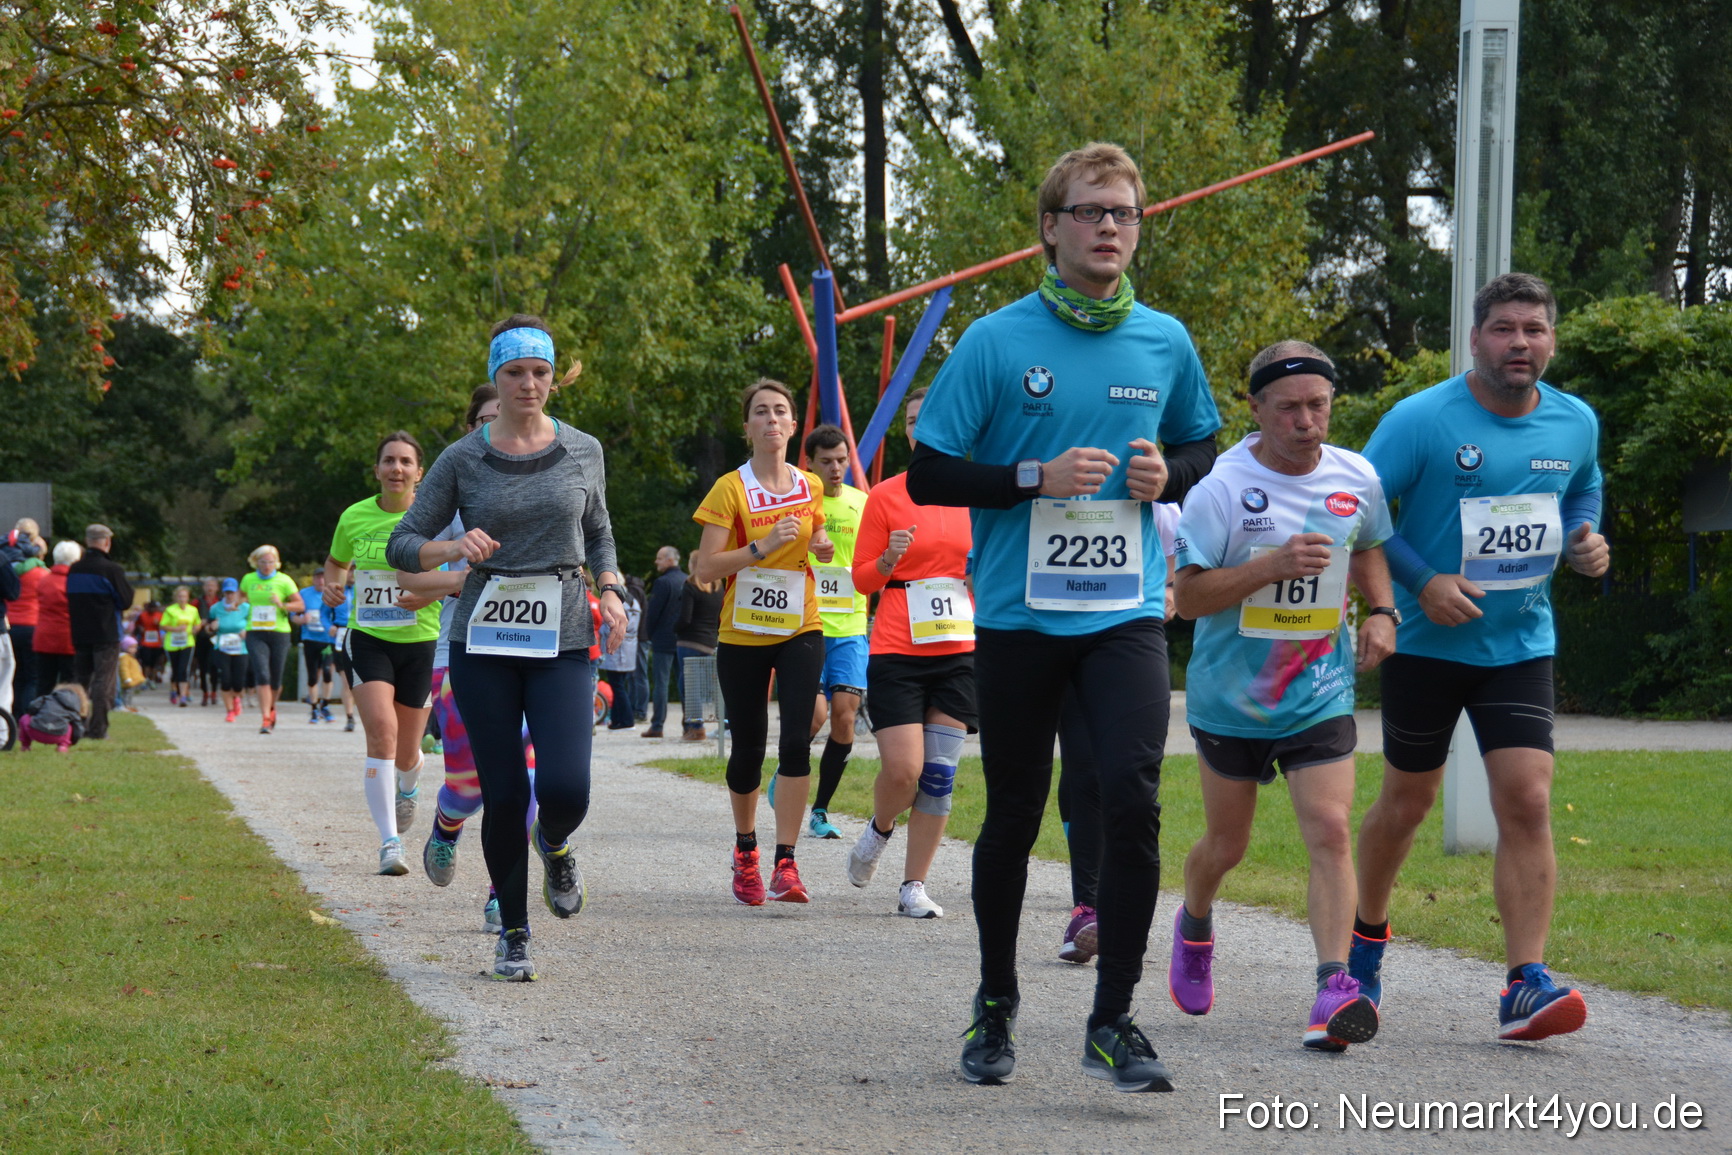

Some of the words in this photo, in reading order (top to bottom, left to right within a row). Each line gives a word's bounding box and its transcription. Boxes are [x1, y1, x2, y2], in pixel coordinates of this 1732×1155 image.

[1109, 386, 1158, 402] BOCK
[1022, 402, 1054, 411] PARTL
[1530, 459, 1570, 471] BOCK
[1455, 474, 1483, 482] PARTL
[1500, 503, 1532, 512] BOCK
[751, 513, 781, 528] MAX
[1077, 511, 1114, 520] BOCK
[1242, 516, 1275, 526] PARTL
[841, 526, 854, 534] RUN
[1478, 523, 1547, 555] 2487
[1046, 534, 1127, 568] 2233
[1497, 562, 1529, 574] Adrian
[821, 579, 838, 594] 94
[1066, 579, 1107, 592] Nathan
[1272, 576, 1319, 604] 161
[364, 587, 405, 604] 2717
[751, 587, 788, 609] 268
[483, 599, 547, 625] 2020
[931, 596, 953, 617] 91
[362, 609, 411, 620] CHRISTINE
[750, 612, 764, 622] Eva
[764, 614, 785, 624] Maria
[1273, 613, 1312, 624] Norbert
[935, 622, 956, 631] Nicole
[496, 631, 531, 642] Kristina
